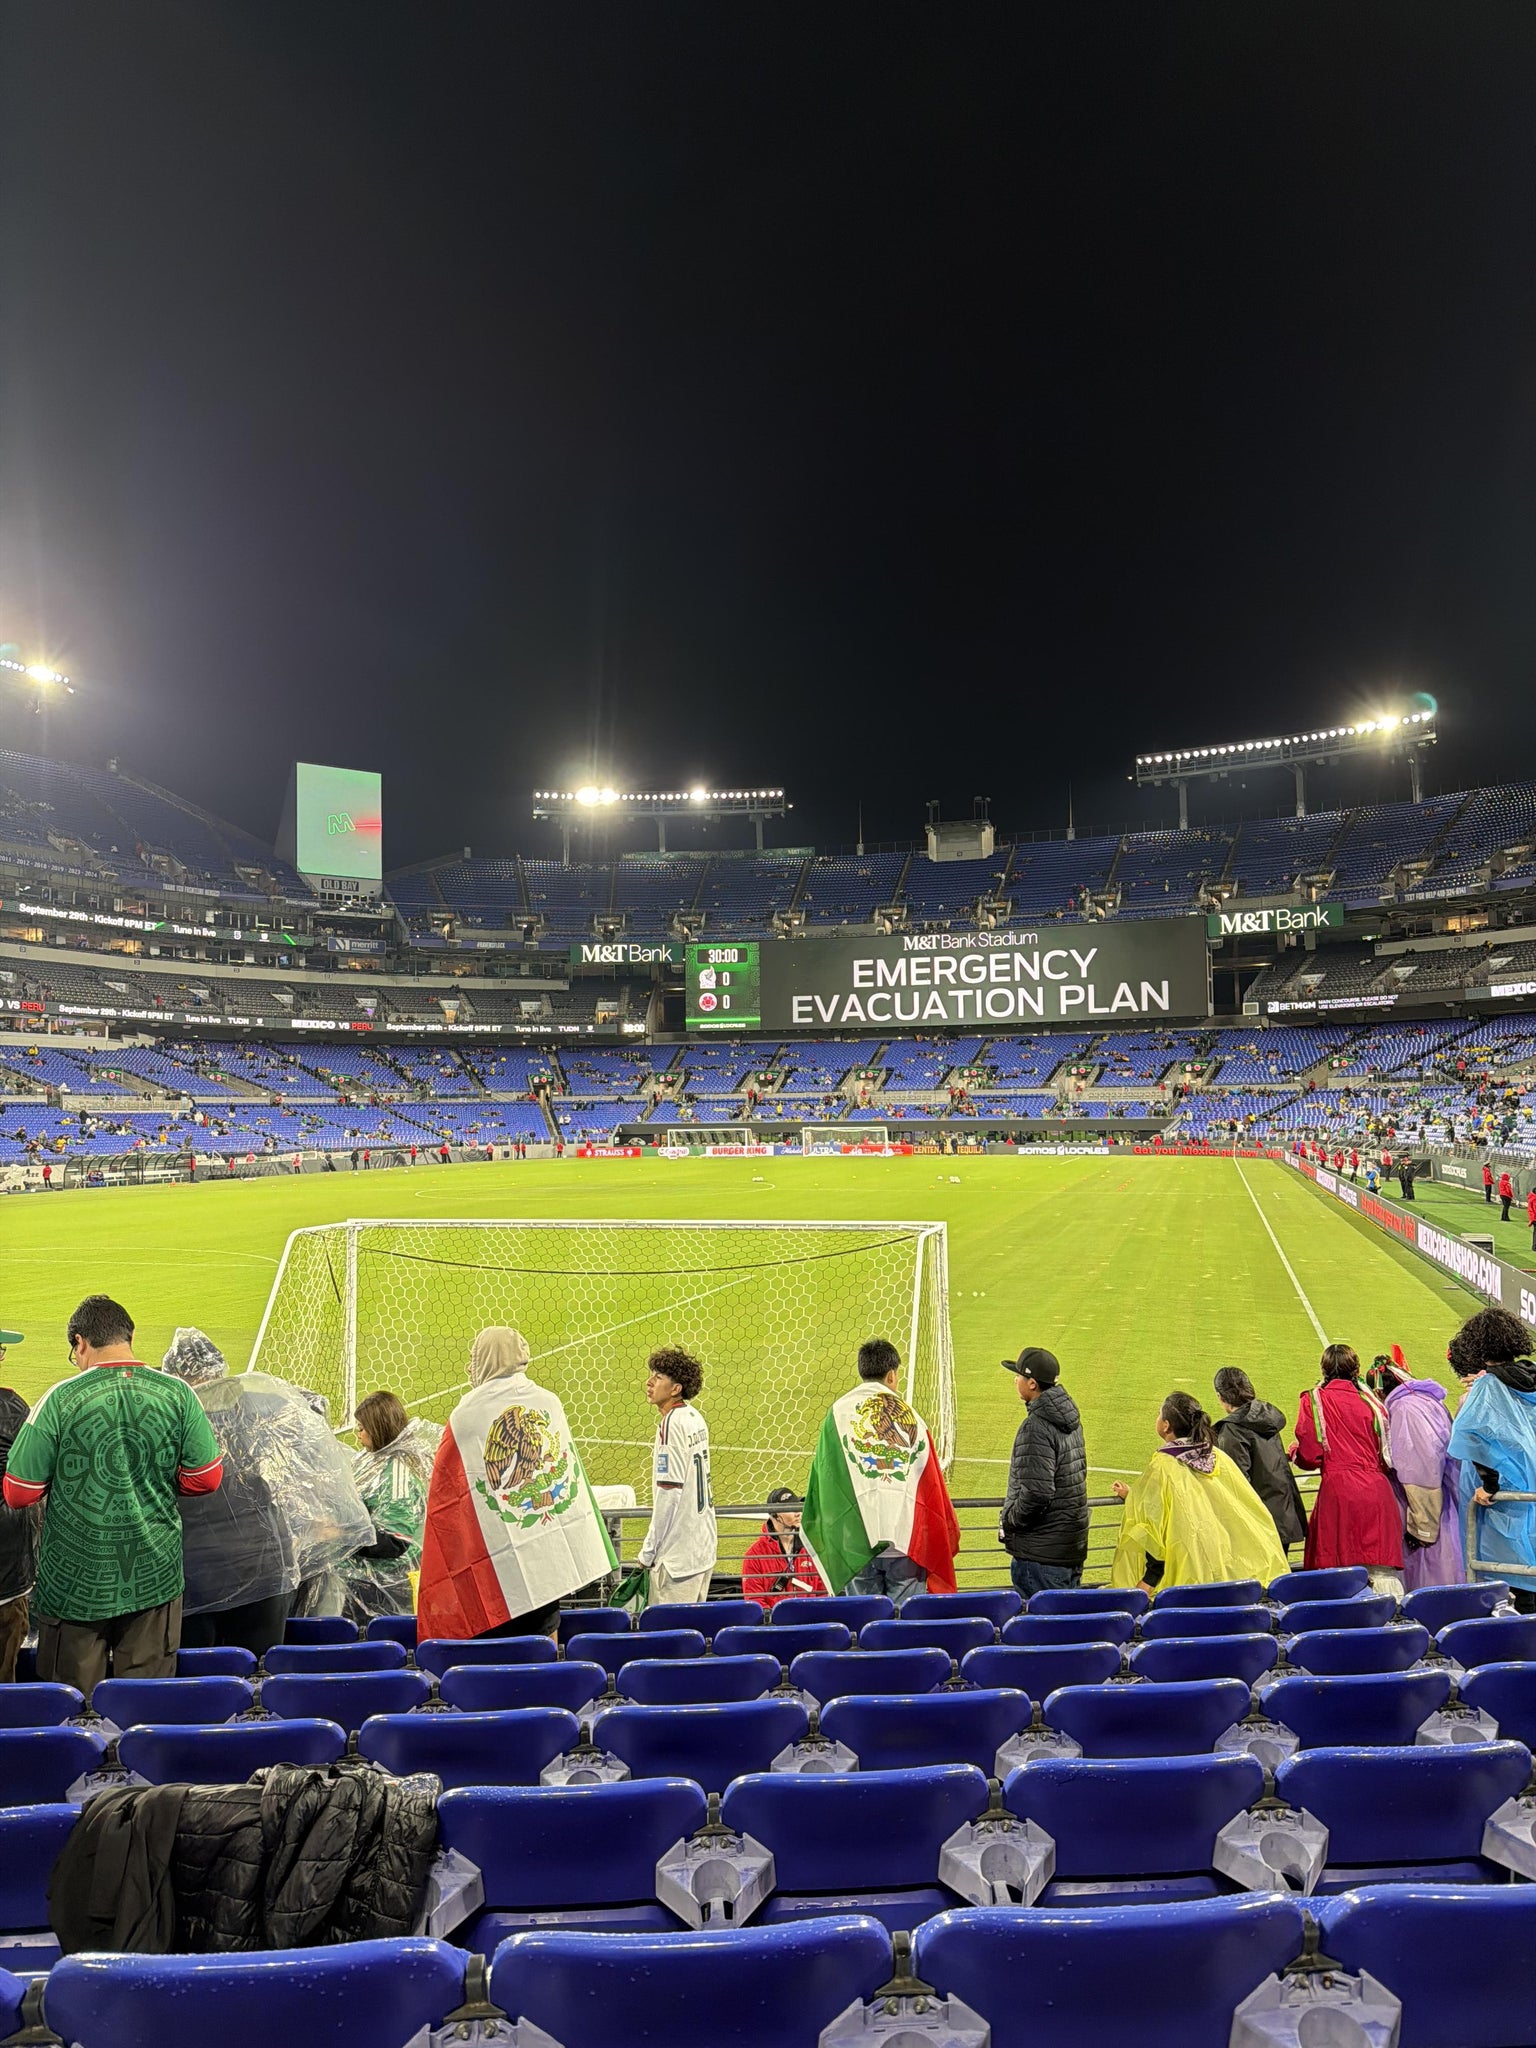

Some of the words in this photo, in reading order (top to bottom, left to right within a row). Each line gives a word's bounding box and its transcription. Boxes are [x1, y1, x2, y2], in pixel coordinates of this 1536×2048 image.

[323, 880, 340, 889] OLD
[341, 881, 358, 891] BAY
[19, 903, 68, 919] September
[94, 914, 123, 927] Kickoff
[1219, 910, 1275, 935] M&T
[1276, 906, 1330, 930] Bank
[172, 924, 192, 935] Tune
[193, 926, 201, 936] in
[202, 927, 217, 938] live
[351, 940, 379, 949] merritt
[903, 934, 941, 951] M&T
[941, 934, 976, 949] Bank
[978, 931, 1039, 948] Stadium
[581, 944, 628, 963] M&T
[629, 944, 673, 962] Bank
[708, 948, 738, 964] 30:00
[853, 948, 1098, 988] EMERGENCY
[722, 971, 730, 986] 0
[7, 1001, 20, 1010] VS
[21, 1002, 46, 1012] PERU
[723, 995, 730, 1010] 0
[792, 986, 1044, 1023] EVACUATION
[1060, 980, 1169, 1015] PLAN
[1280, 1002, 1316, 1011] BETMGM
[59, 1005, 99, 1016] September
[122, 1009, 147, 1019] Kickoff
[164, 1013, 174, 1021] ET
[185, 1014, 200, 1023] Tune
[208, 1016, 221, 1024] live
[227, 1017, 249, 1025] TUDN
[291, 1019, 336, 1030] MEXICO
[339, 1022, 350, 1030] VS
[351, 1022, 374, 1031] PERU
[386, 1023, 425, 1032] September
[448, 1024, 473, 1032] Kickoff
[540, 1025, 552, 1033] live
[594, 1149, 624, 1157] STRAUSS
[712, 1147, 744, 1155] BURGER
[746, 1147, 767, 1155] KING
[957, 1145, 983, 1154] TEQUILA
[1018, 1146, 1057, 1155] SOMOS
[1065, 1146, 1109, 1155] LOCALES
[1133, 1146, 1152, 1155] Get
[1155, 1147, 1179, 1156] your
[1181, 1147, 1219, 1155] Mexico
[1265, 1149, 1284, 1159] Visit
